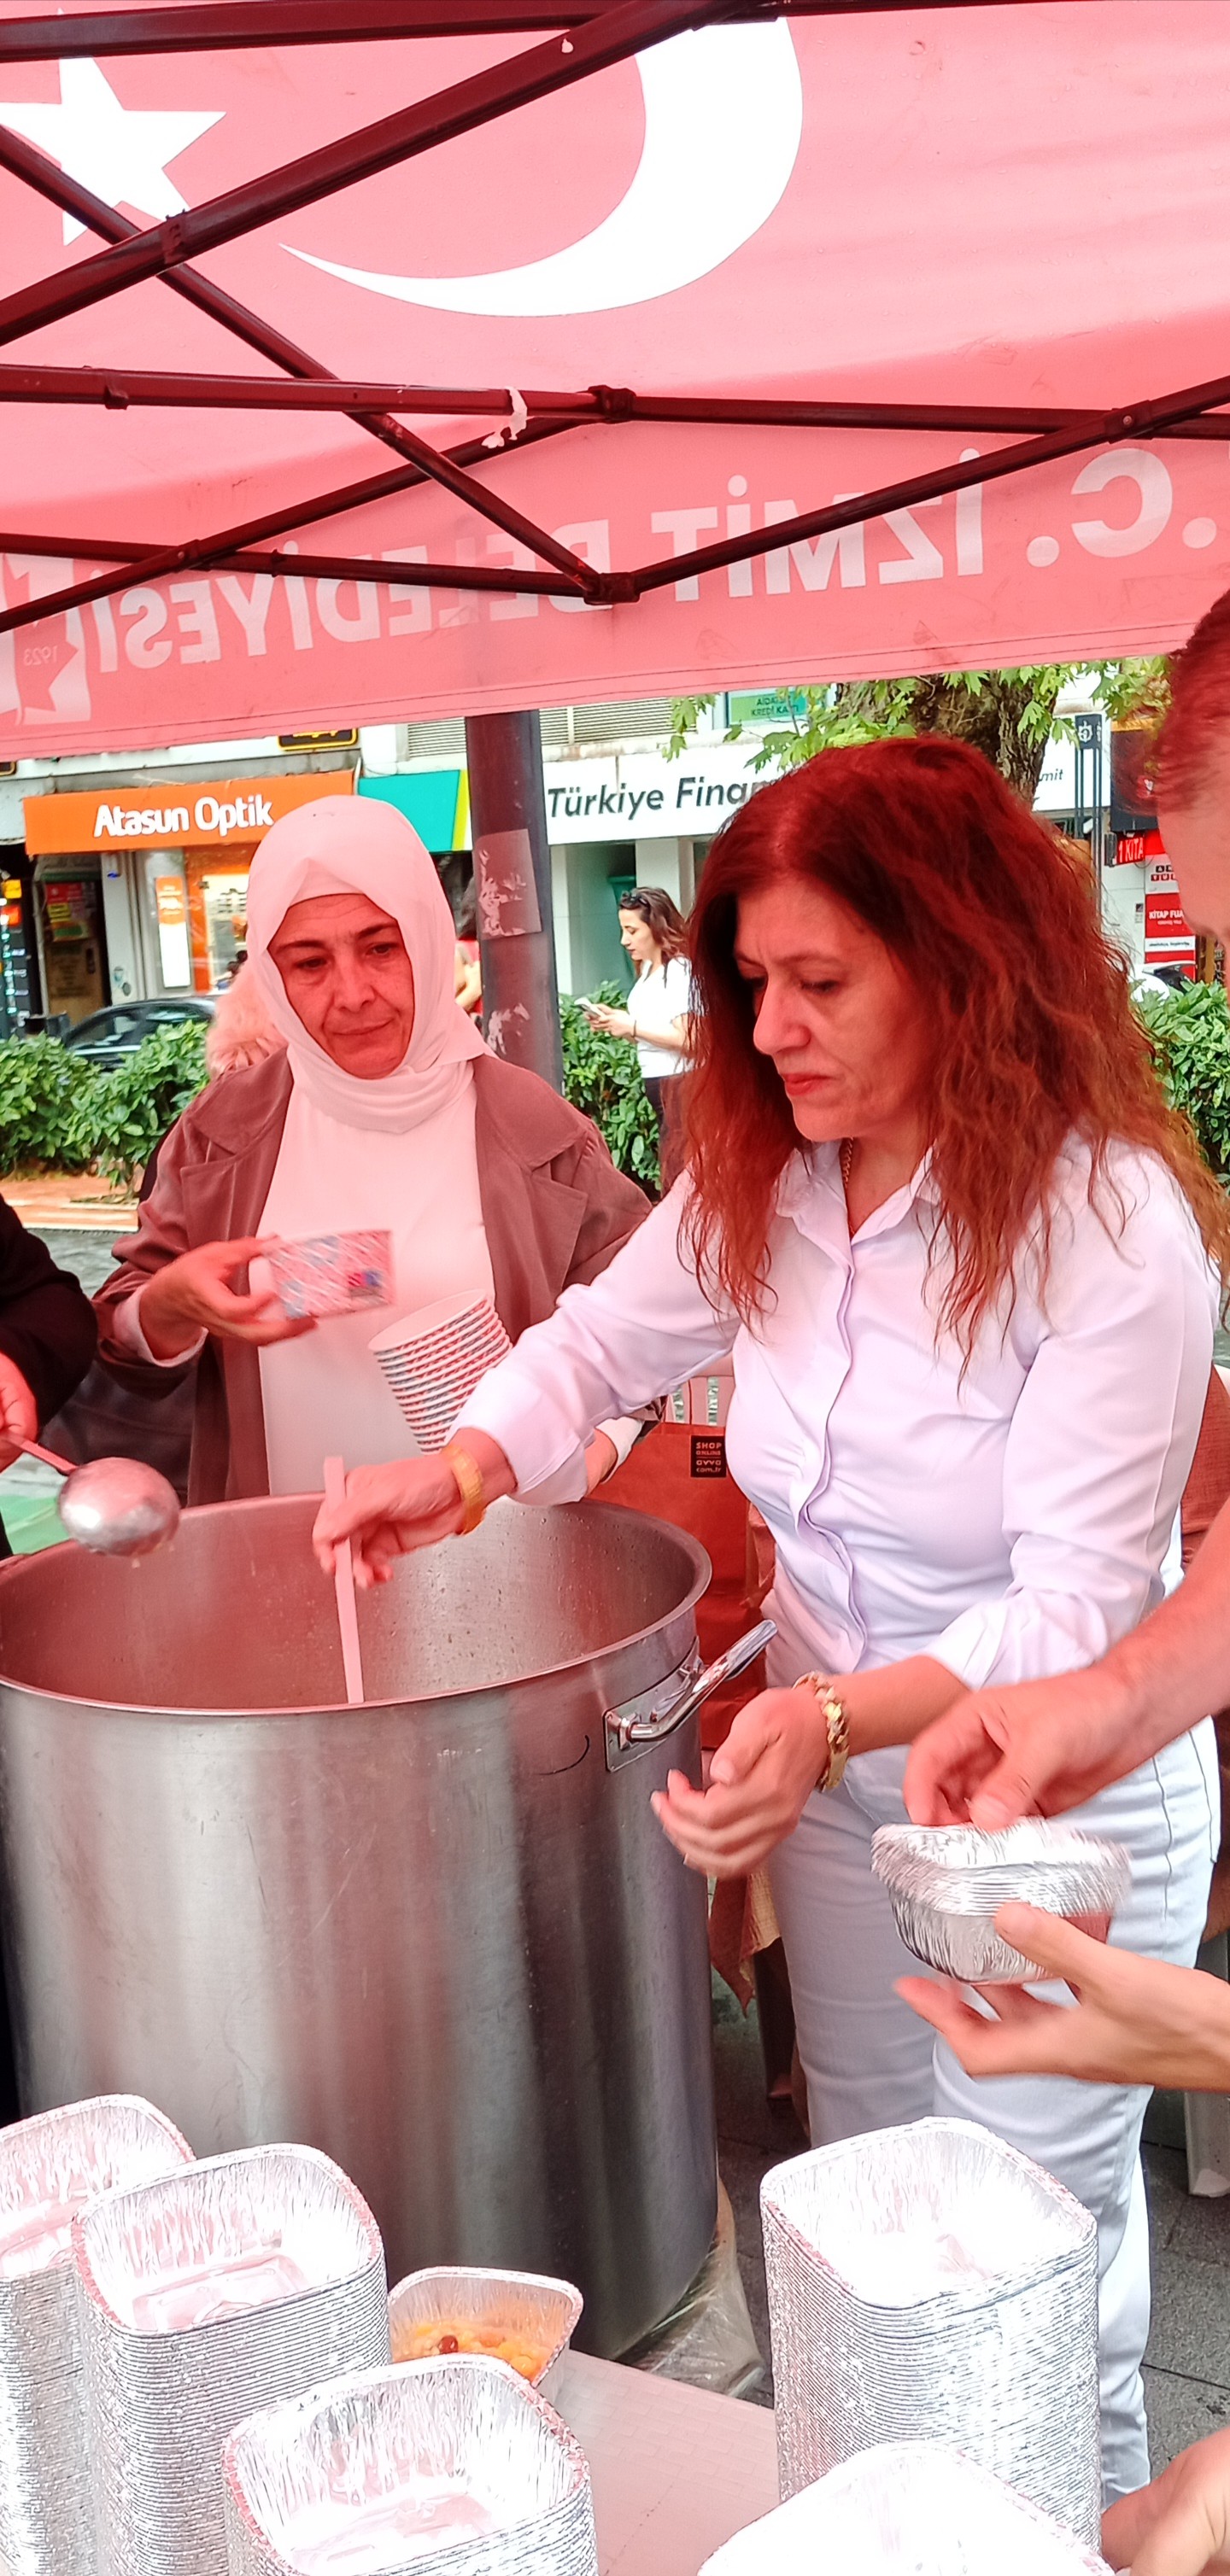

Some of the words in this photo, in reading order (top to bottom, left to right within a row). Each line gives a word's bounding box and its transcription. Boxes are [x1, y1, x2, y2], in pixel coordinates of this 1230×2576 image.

[1039, 768, 1063, 782] mit
[548, 782, 665, 821] Türkiye
[93, 804, 190, 838] Atasun
[194, 793, 275, 837] Optik
[1169, 909, 1184, 919] FUA
